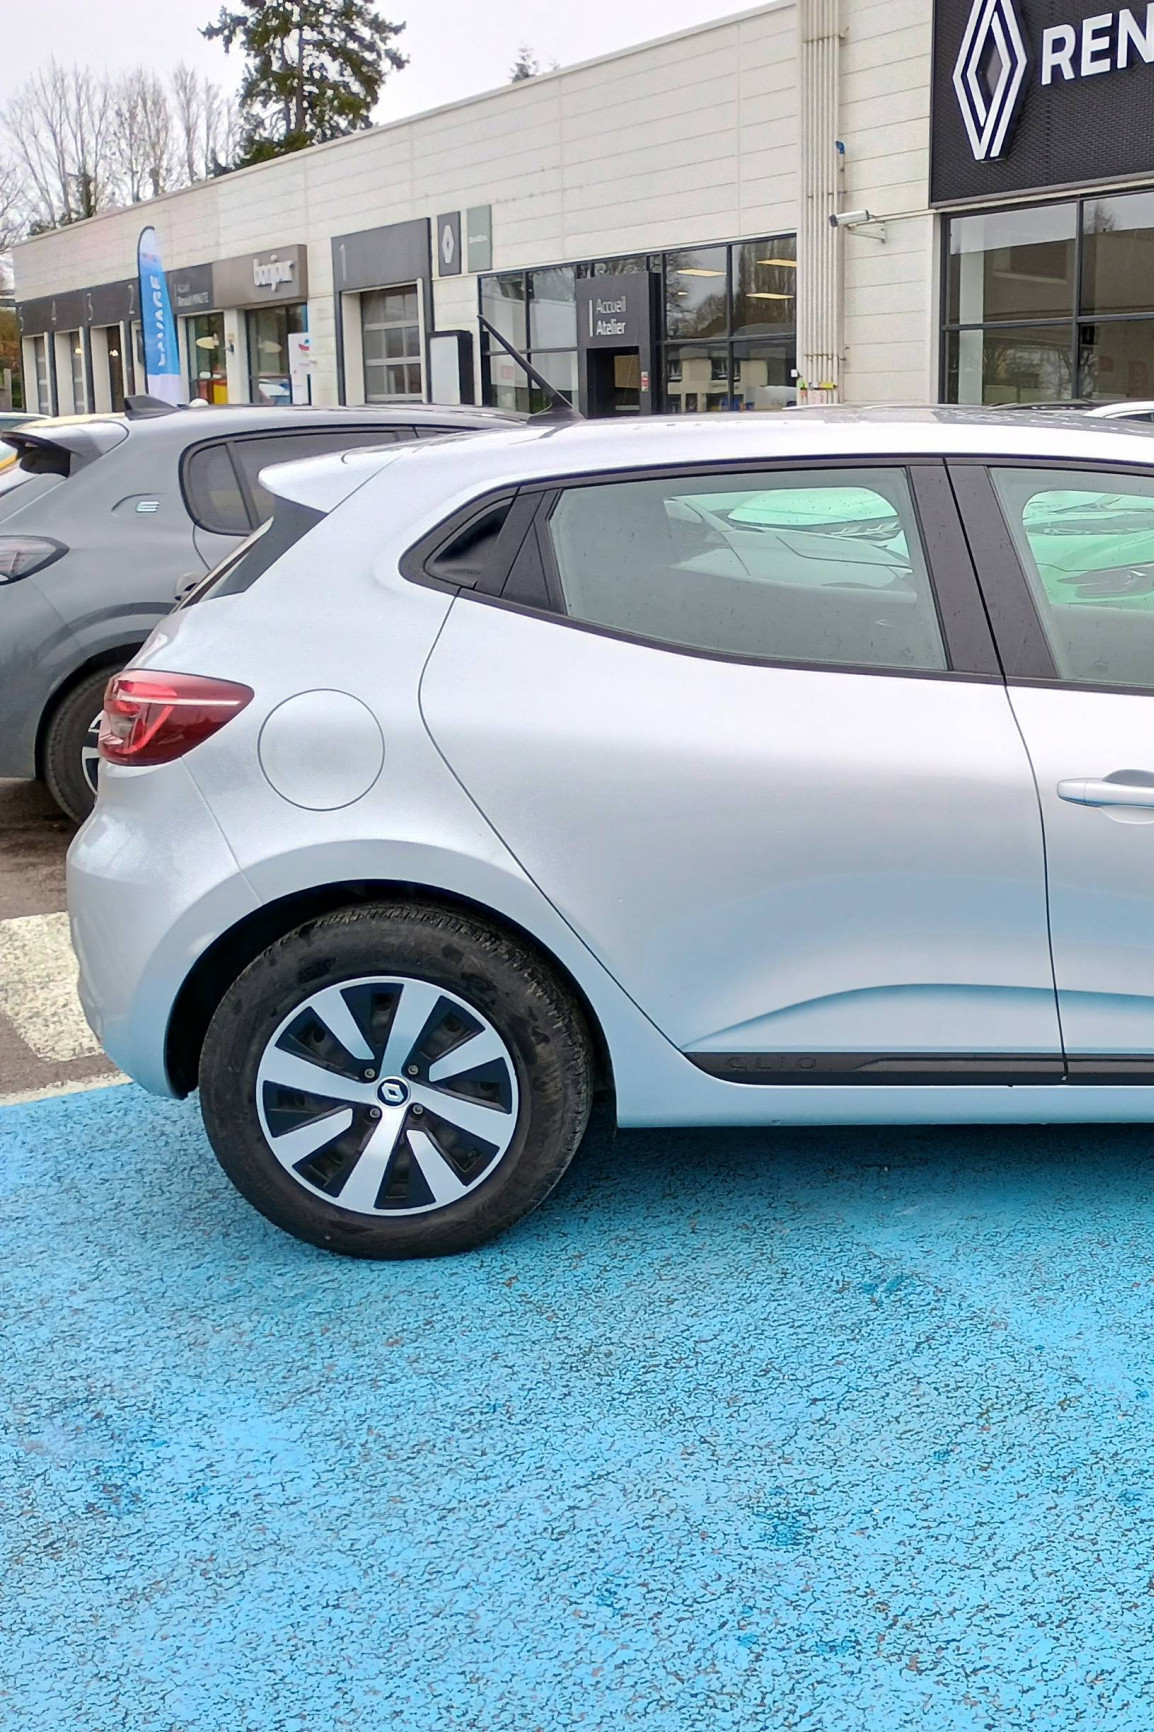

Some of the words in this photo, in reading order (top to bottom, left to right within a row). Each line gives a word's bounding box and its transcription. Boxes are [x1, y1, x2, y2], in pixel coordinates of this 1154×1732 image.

[596, 295, 626, 313] Accueil
[595, 318, 626, 336] Atelier
[727, 1056, 817, 1070] CLIO
